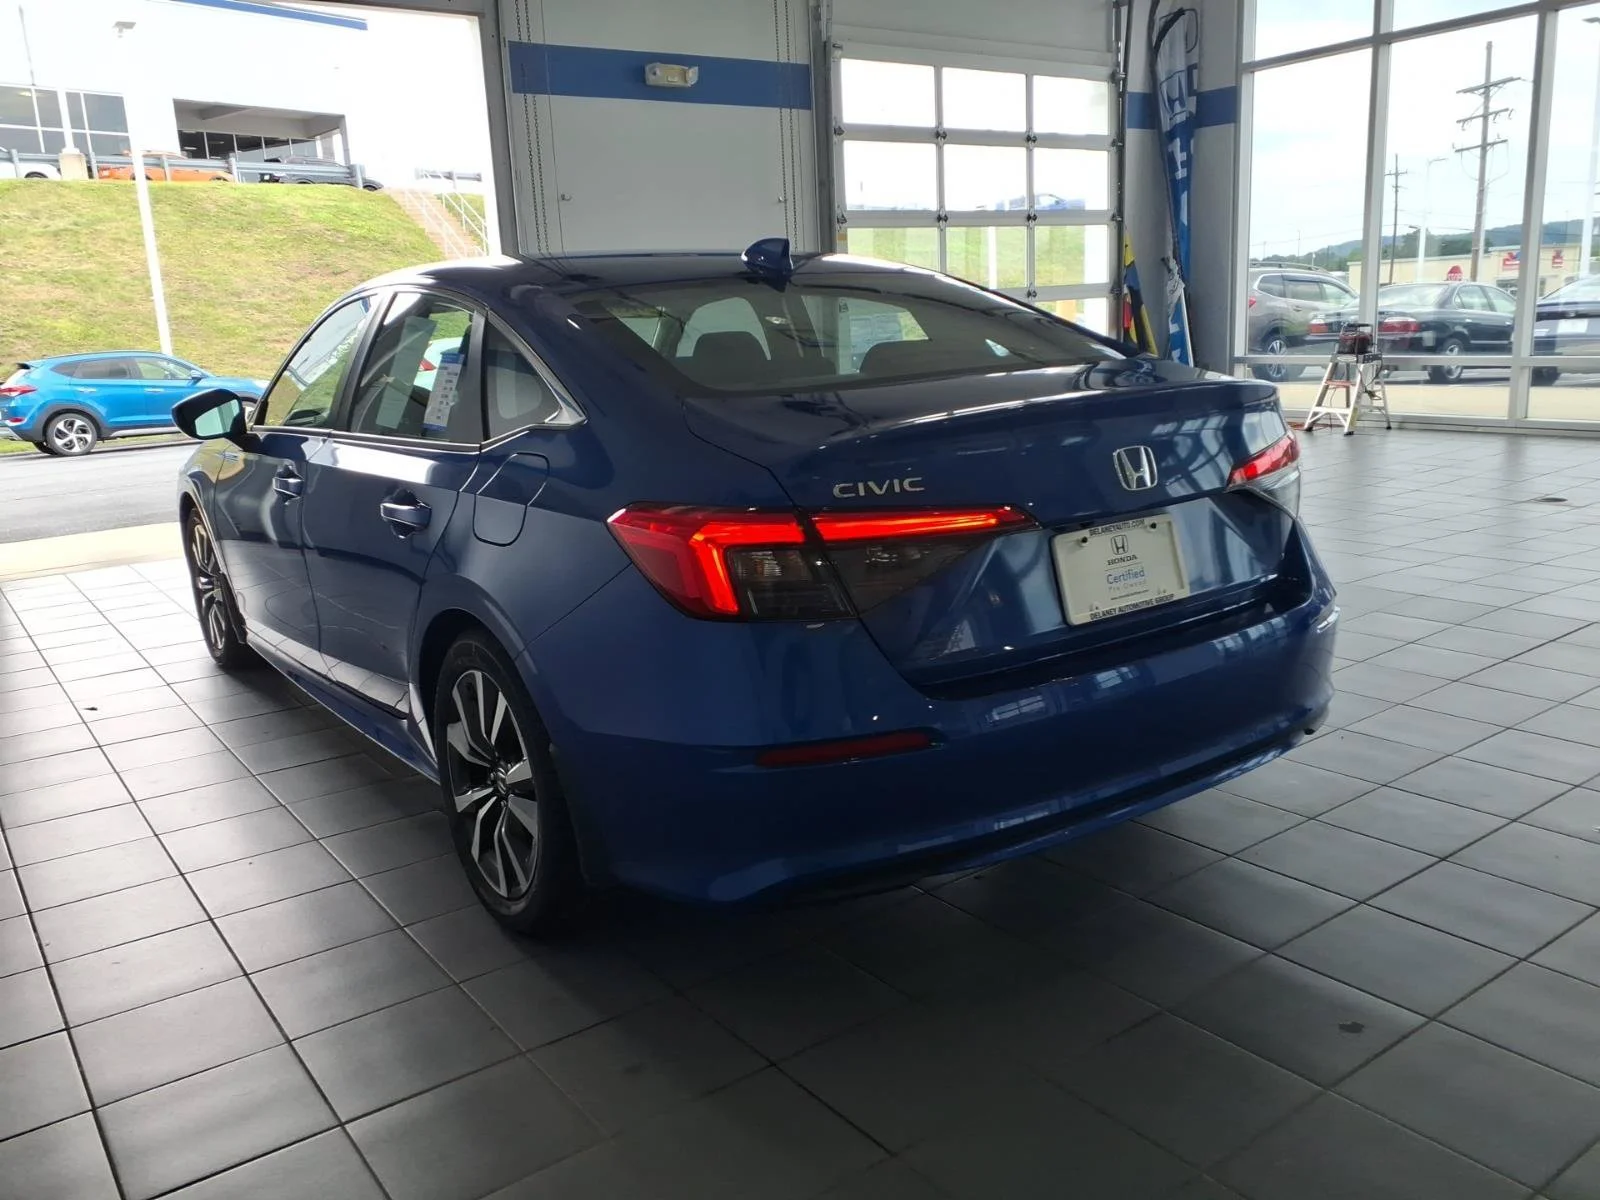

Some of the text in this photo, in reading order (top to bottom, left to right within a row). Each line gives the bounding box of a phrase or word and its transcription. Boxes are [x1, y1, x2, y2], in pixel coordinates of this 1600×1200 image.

[832, 477, 925, 498] CIVIC
[1089, 518, 1146, 537] DELANEYAUTO.COM
[1107, 554, 1138, 566] HONDA
[1106, 566, 1145, 585] Certified
[1089, 608, 1117, 620] DELANEY
[1118, 598, 1154, 613] AUTOMOTIVE
[1155, 593, 1174, 605] GROUP
